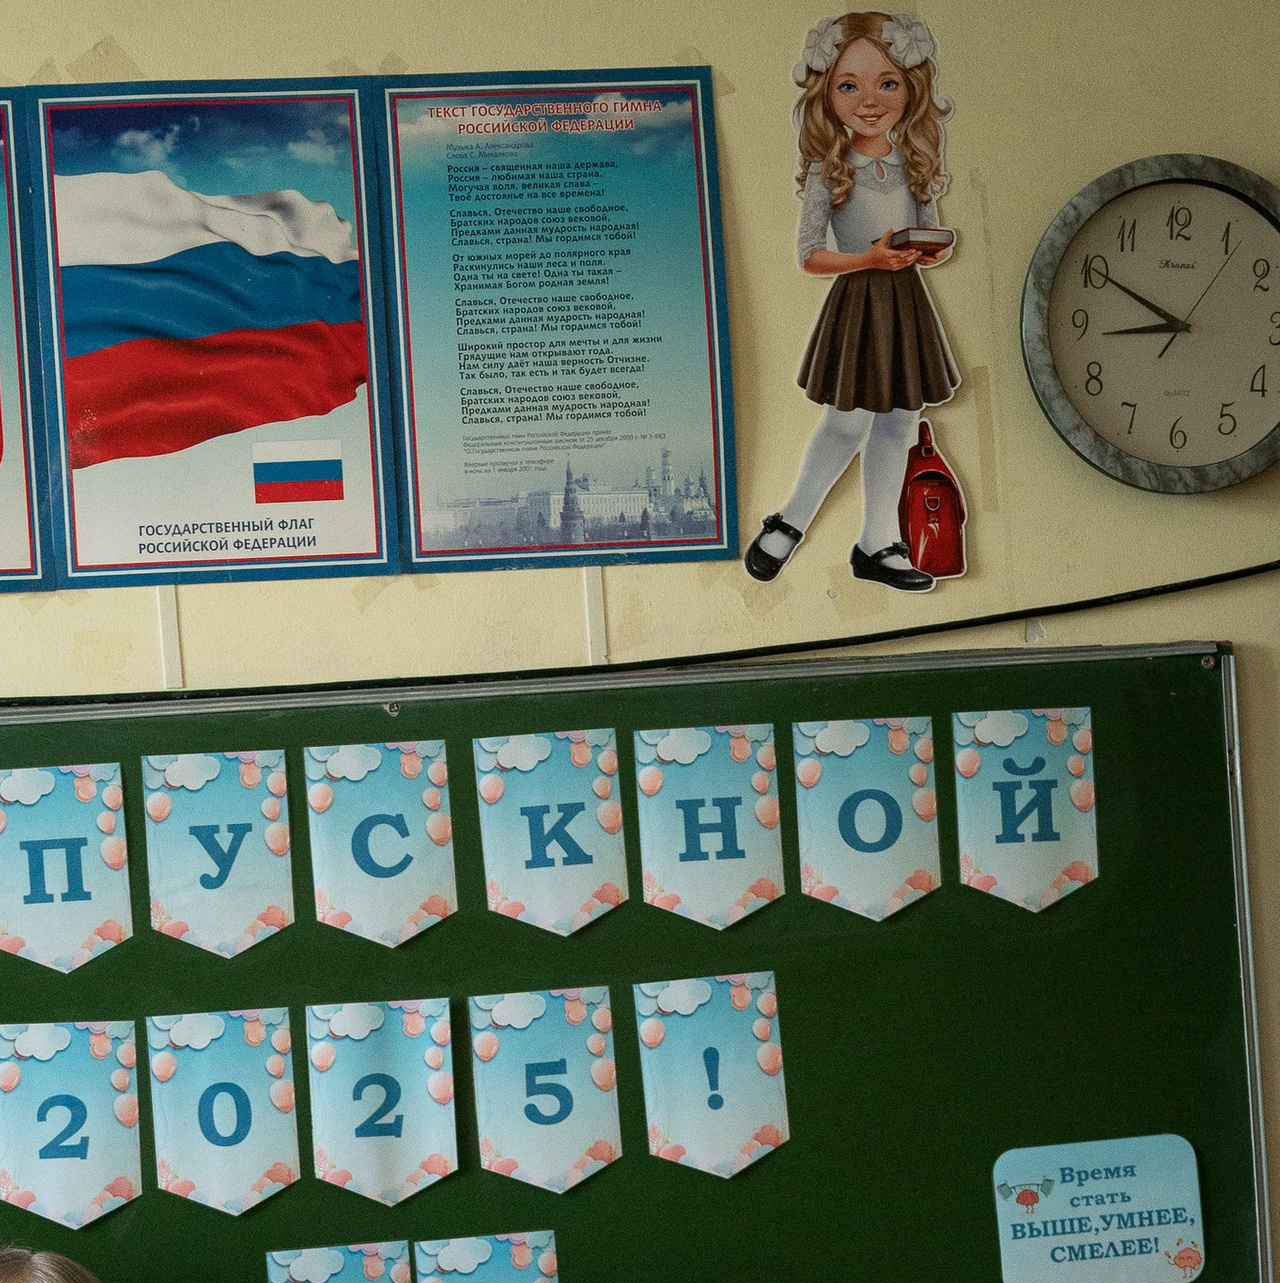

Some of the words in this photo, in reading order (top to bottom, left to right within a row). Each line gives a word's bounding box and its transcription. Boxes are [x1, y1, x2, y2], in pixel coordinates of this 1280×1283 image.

[428, 107, 466, 118] ТЕКСТ
[471, 102, 608, 117] ГОСУДАРСТВЕННОГО
[613, 100, 661, 112] ГИМНА
[458, 119, 546, 134] РОССИЙСКОЙ
[551, 118, 634, 132] ФЕДЕРАЦИИ
[489, 163, 543, 172] священная
[573, 161, 618, 170] держава,
[447, 174, 480, 182] Россия
[490, 172, 536, 180] любимая
[566, 171, 603, 180] страна.
[447, 184, 490, 193] Могучая
[492, 183, 519, 191] воля,
[448, 193, 472, 201] Твоё
[473, 192, 524, 201] достоянье
[559, 189, 605, 199] времена!
[493, 207, 543, 215] Отечество
[573, 204, 628, 213] свободное,
[450, 219, 494, 228] Братских
[497, 217, 539, 226] народов
[567, 214, 611, 222] вековой,
[1166, 205, 1192, 241] 12
[450, 228, 501, 237] Предками
[503, 227, 539, 235] данная
[540, 225, 587, 234] мудрость
[589, 222, 639, 232] народная!
[1116, 219, 1136, 252] 11
[495, 235, 532, 245] страна!
[535, 235, 553, 243] Мы
[555, 234, 601, 243] гордимся
[603, 232, 636, 240] тобой!
[1221, 222, 1231, 255] 1
[504, 251, 536, 261] морей
[553, 250, 606, 259] полярного
[608, 249, 631, 258] края
[451, 263, 515, 271] Раскинулись
[1081, 254, 1109, 289] 10
[452, 273, 478, 281] Одна
[510, 270, 541, 278] свете!
[543, 270, 569, 278] Одна
[1253, 258, 1270, 292] 2
[453, 282, 503, 291] Хранимая
[505, 280, 536, 288] Богом
[538, 280, 574, 289] родная
[576, 277, 609, 286] земля!
[454, 298, 496, 306] Славься,
[579, 293, 634, 302] свободное,
[455, 308, 500, 317] Братских
[502, 306, 544, 315] народов
[572, 302, 616, 311] вековой,
[455, 317, 506, 326] Предками
[508, 316, 544, 324] данная
[546, 314, 592, 323] мудрость
[594, 311, 645, 321] народная!
[1072, 308, 1088, 341] 9
[455, 326, 498, 334] Славься,
[500, 324, 537, 334] страна!
[540, 323, 558, 331] Мы
[560, 323, 607, 332] гордимся
[609, 320, 641, 328] тобой!
[457, 341, 503, 351] Широкий
[505, 341, 546, 350] простор
[548, 340, 566, 348] для
[632, 336, 662, 344] жизни
[457, 352, 507, 361] Грядущие
[531, 349, 585, 358] открывают
[481, 362, 505, 370] силу
[507, 359, 529, 369] даёт
[560, 358, 604, 367] верность
[606, 356, 649, 364] Отчизне.
[458, 371, 476, 379] Так
[478, 370, 508, 378] было,
[578, 367, 606, 376] будет
[609, 364, 645, 373] всегда!
[1085, 361, 1103, 396] 8
[1250, 363, 1268, 397] 4
[459, 387, 502, 395] Славься,
[504, 385, 554, 393] Отечество
[584, 382, 639, 390] свободное,
[460, 397, 505, 406] Братских
[507, 395, 549, 404] народов
[577, 391, 621, 400] вековой,
[461, 406, 511, 416] Предками
[513, 405, 549, 413] данная
[551, 403, 597, 412] мудрость
[599, 399, 650, 410] народная!
[505, 413, 542, 423] страна!
[545, 412, 563, 420] Мы
[565, 411, 612, 421] гордимся
[613, 409, 646, 417] тобой!
[1121, 401, 1137, 434] 7
[1218, 401, 1237, 435] 5
[1170, 416, 1187, 449] 6
[139, 518, 273, 537] ГОСУДАРСТВЕННЫЙ
[278, 518, 315, 531] ФЛАГ
[139, 537, 229, 554] РОССИЙСКОЙ
[233, 535, 317, 551] ФЕДЕРАЦИИ
[1059, 1164, 1137, 1187] Время
[1070, 1192, 1131, 1208] стать
[1050, 1237, 1160, 1263] СМЕЛЕЕ!
